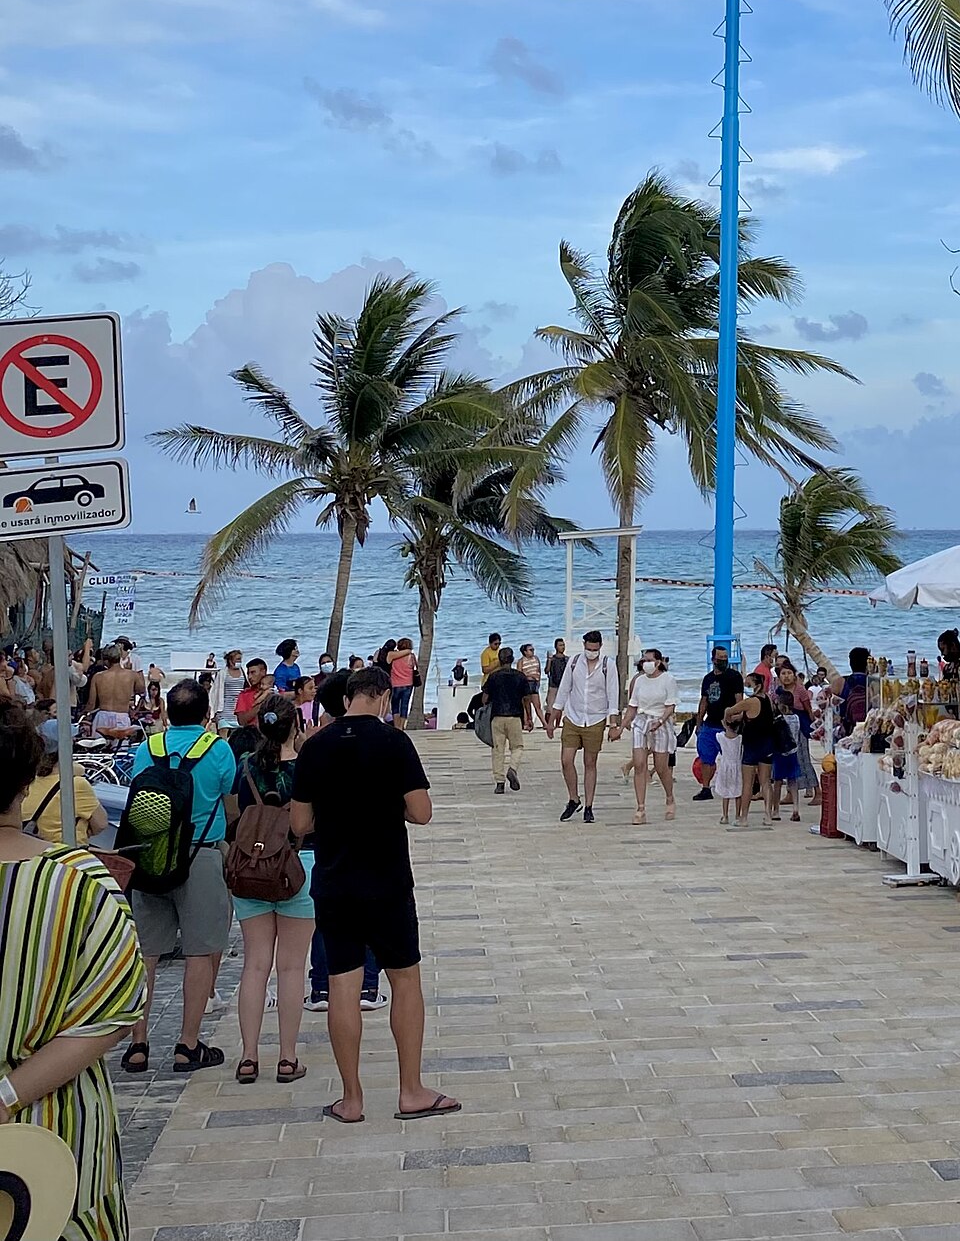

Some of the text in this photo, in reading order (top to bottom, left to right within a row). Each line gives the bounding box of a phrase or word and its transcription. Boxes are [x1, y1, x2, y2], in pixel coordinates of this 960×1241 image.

[24, 355, 70, 417] E
[1, 509, 116, 529] e usará inmovilizador
[88, 576, 116, 586] CLUB
